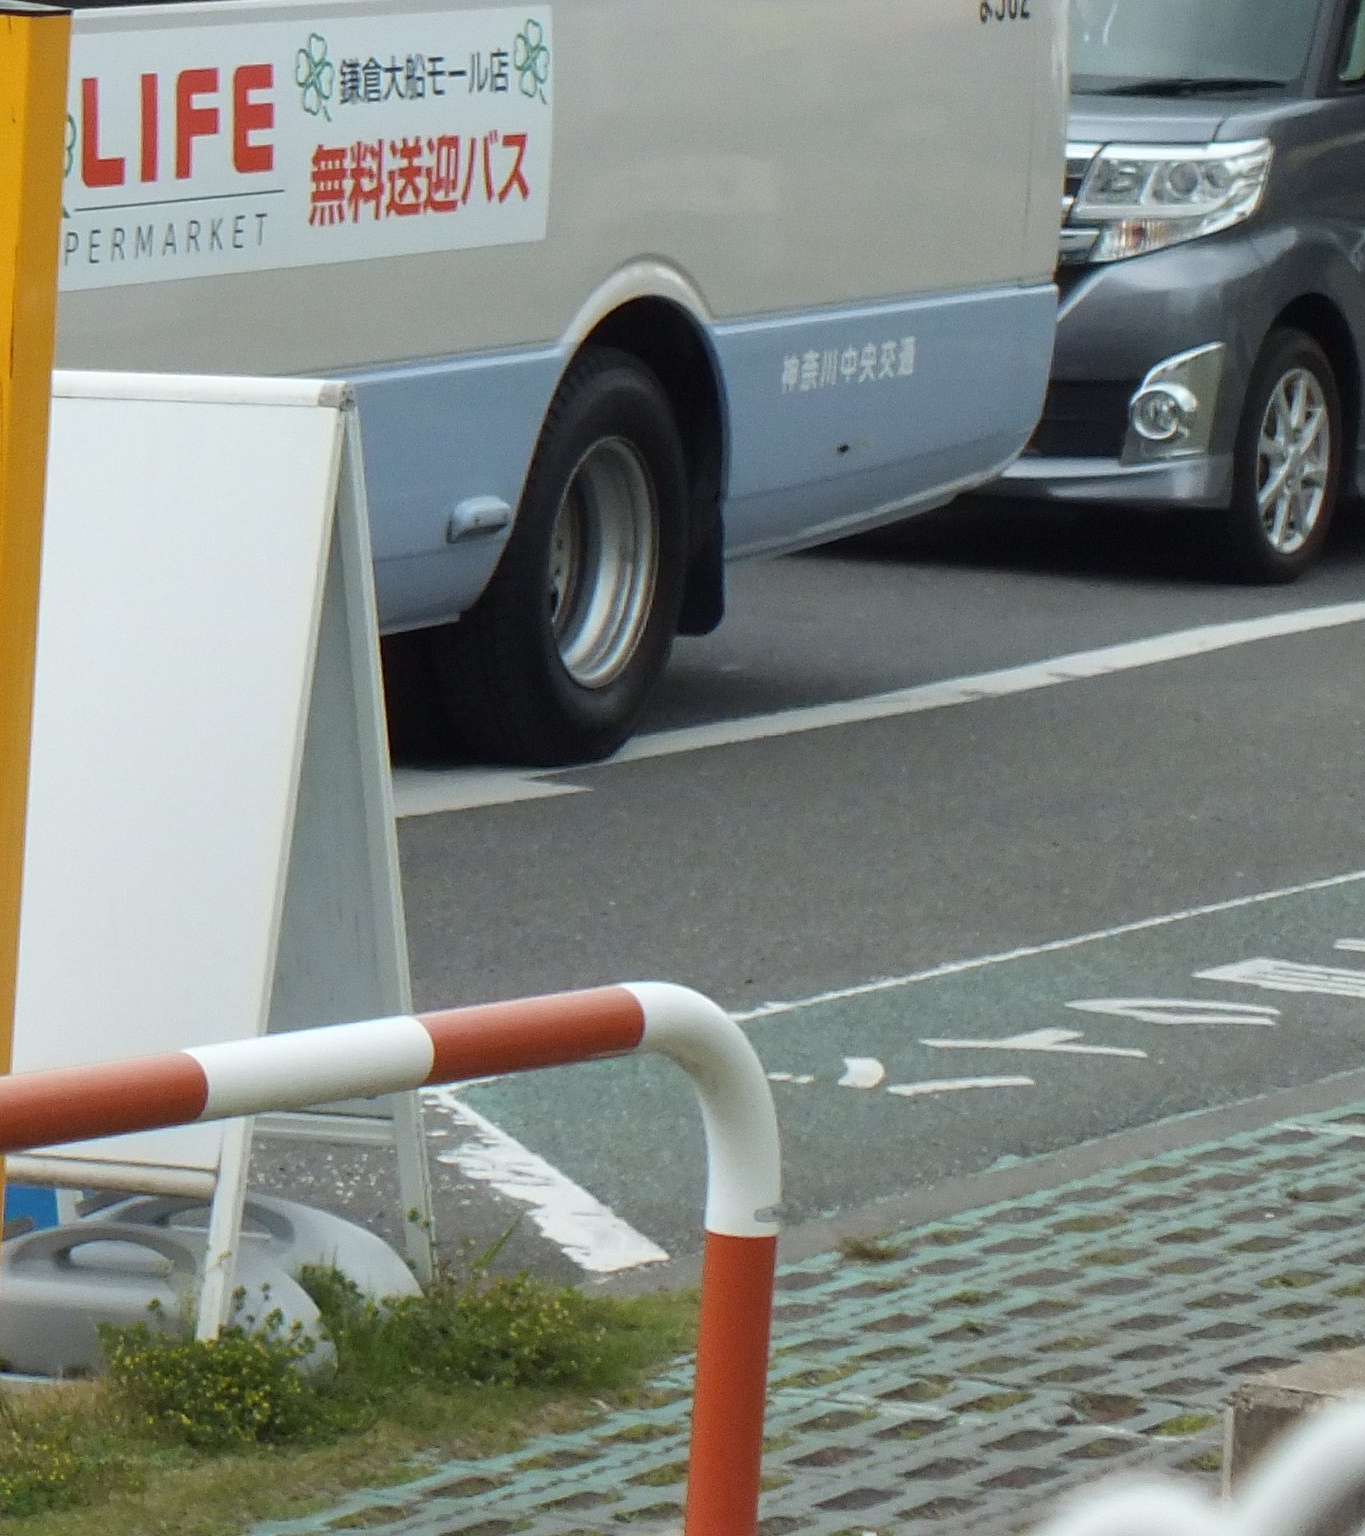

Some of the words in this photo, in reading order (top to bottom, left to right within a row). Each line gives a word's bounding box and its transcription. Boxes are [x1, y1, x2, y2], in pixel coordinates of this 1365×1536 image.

[339, 46, 511, 107] 鎌倉大船モール店
[80, 62, 275, 189] LIFE
[307, 130, 531, 228] 無料送迎バス
[64, 212, 269, 267] PERMARKET
[779, 334, 918, 395] 神奈川中央交通
